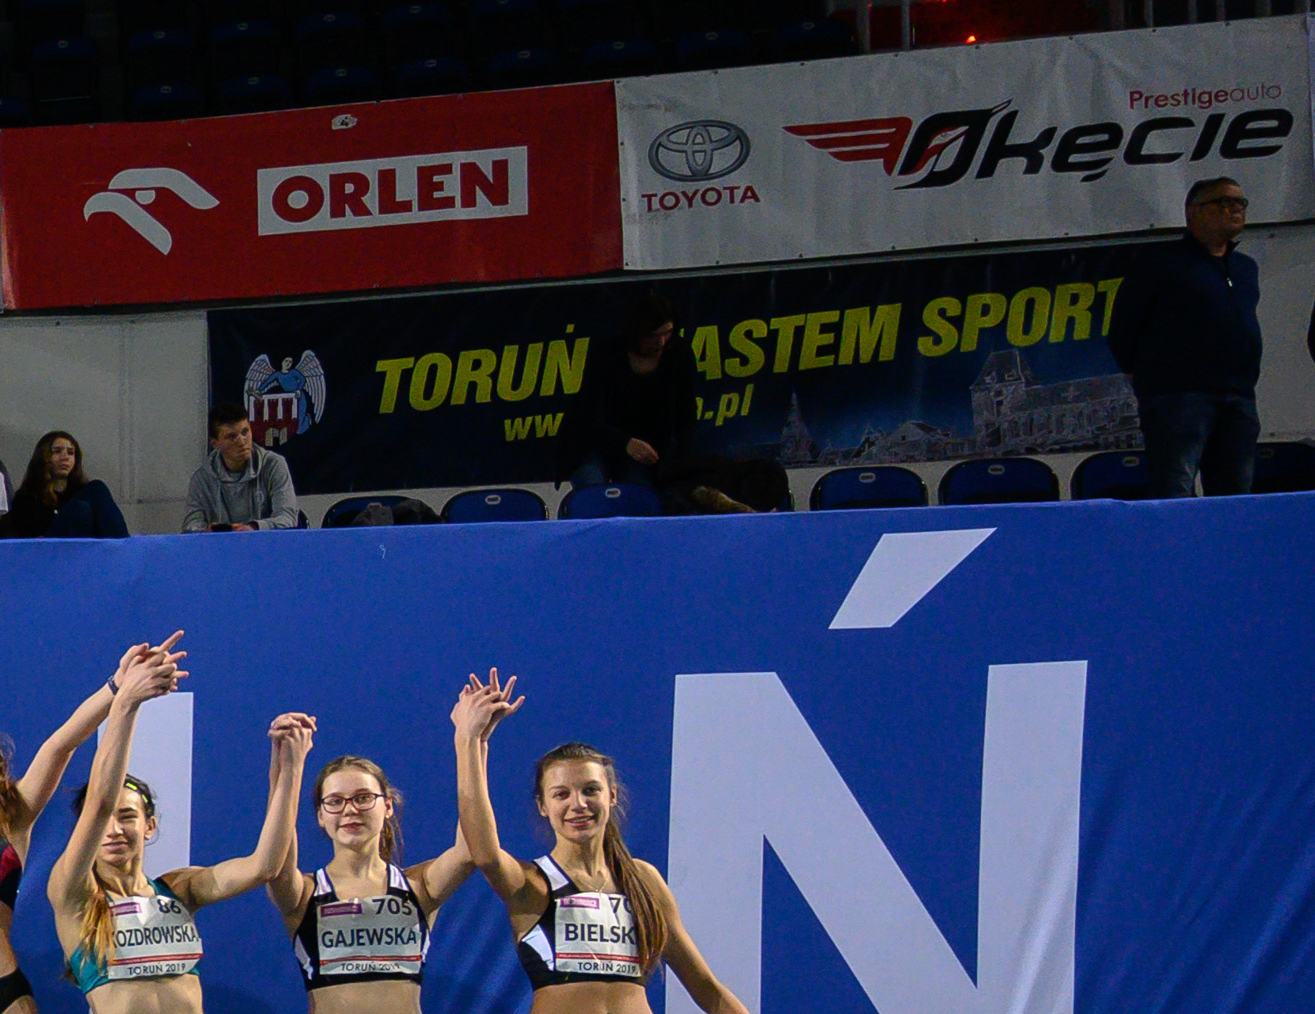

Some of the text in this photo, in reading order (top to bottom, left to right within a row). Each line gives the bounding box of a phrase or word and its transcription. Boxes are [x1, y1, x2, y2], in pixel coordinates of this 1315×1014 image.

[1129, 82, 1282, 110] Prestigeauto
[271, 157, 512, 224] ORLEN
[641, 183, 760, 214] TOYOTA
[374, 277, 1124, 413] TORUŃ ASTEM SPORT
[372, 900, 413, 917] 705
[321, 928, 418, 949] GAJEWSKA
[564, 923, 636, 945] BIELSK
[127, 962, 186, 976] TORUŃ 2019
[340, 961, 377, 973] TORUŃ
[578, 960, 637, 974] TORUŃ 2019
